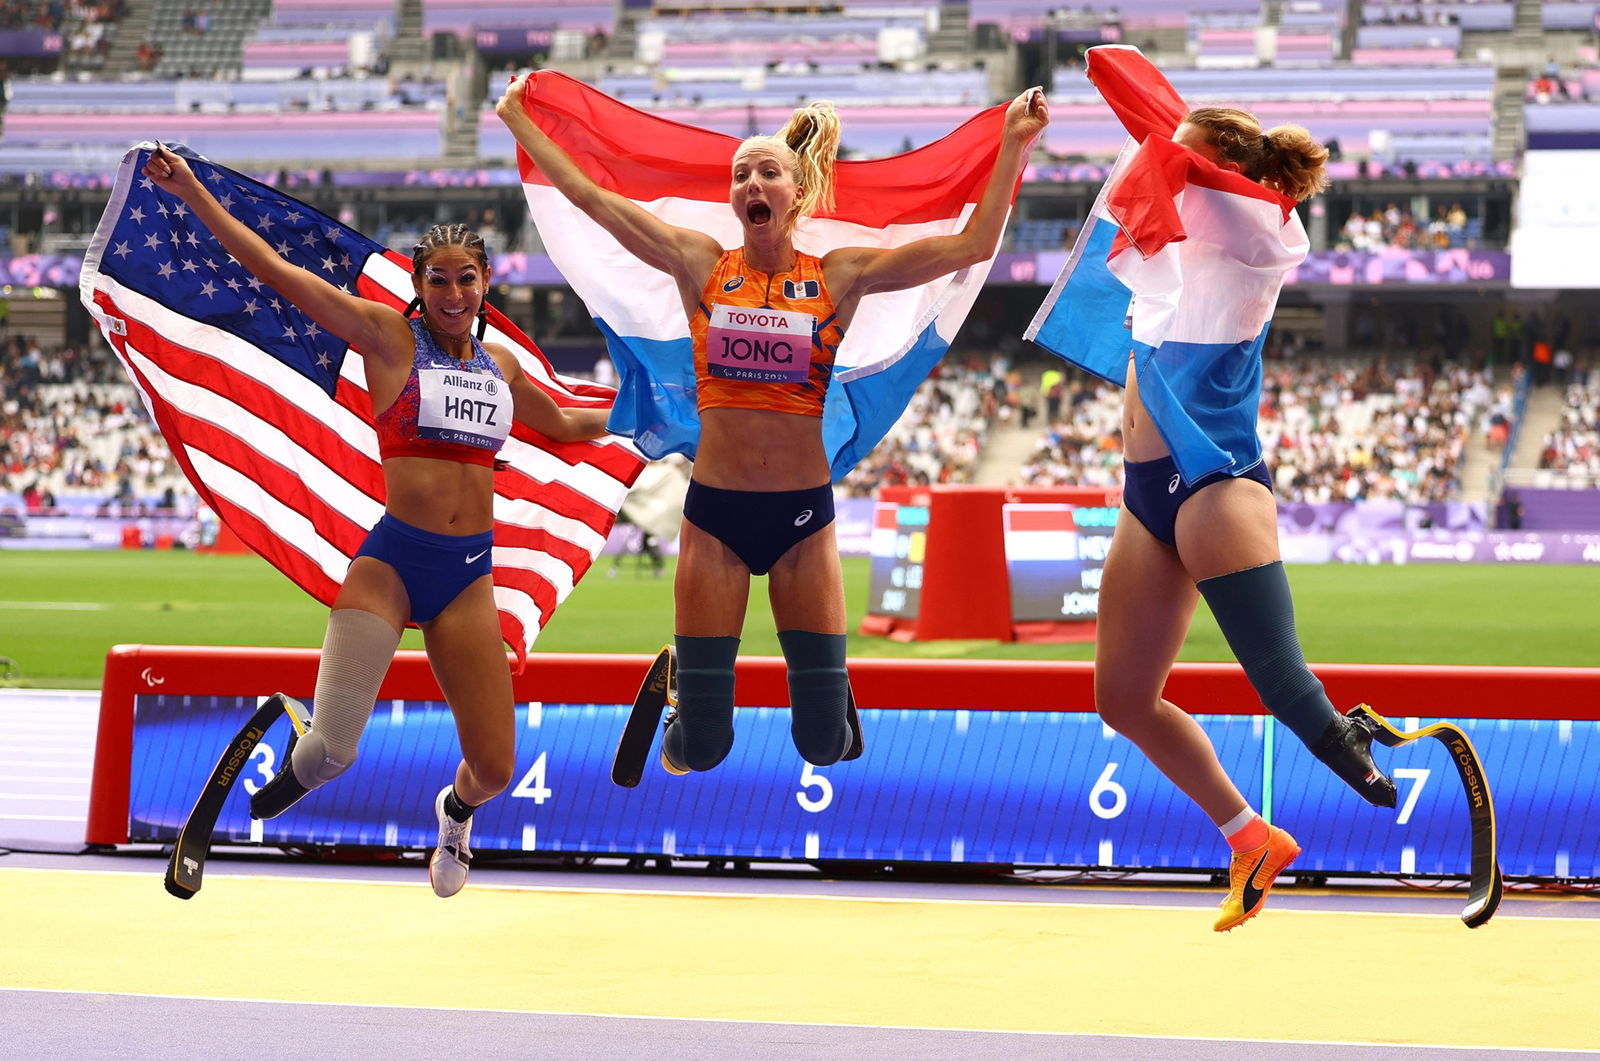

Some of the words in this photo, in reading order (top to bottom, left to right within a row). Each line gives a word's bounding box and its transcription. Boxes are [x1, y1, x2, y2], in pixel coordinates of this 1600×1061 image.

[727, 312, 789, 329] TOYOTA
[721, 336, 793, 364] JONG
[443, 375, 483, 391] Allianz
[736, 371, 762, 380] PARIS
[764, 373, 788, 381] 2024
[444, 395, 498, 427] HATZ
[453, 433, 475, 443] PARIS
[476, 438, 493, 447] 2024
[217, 738, 255, 787] ÖSSUR
[243, 742, 275, 796] 3
[511, 751, 552, 805] 4
[796, 760, 833, 813] 5
[1459, 753, 1483, 809] ÖSSUR
[1088, 762, 1127, 819] 6
[1393, 768, 1431, 825] 7
